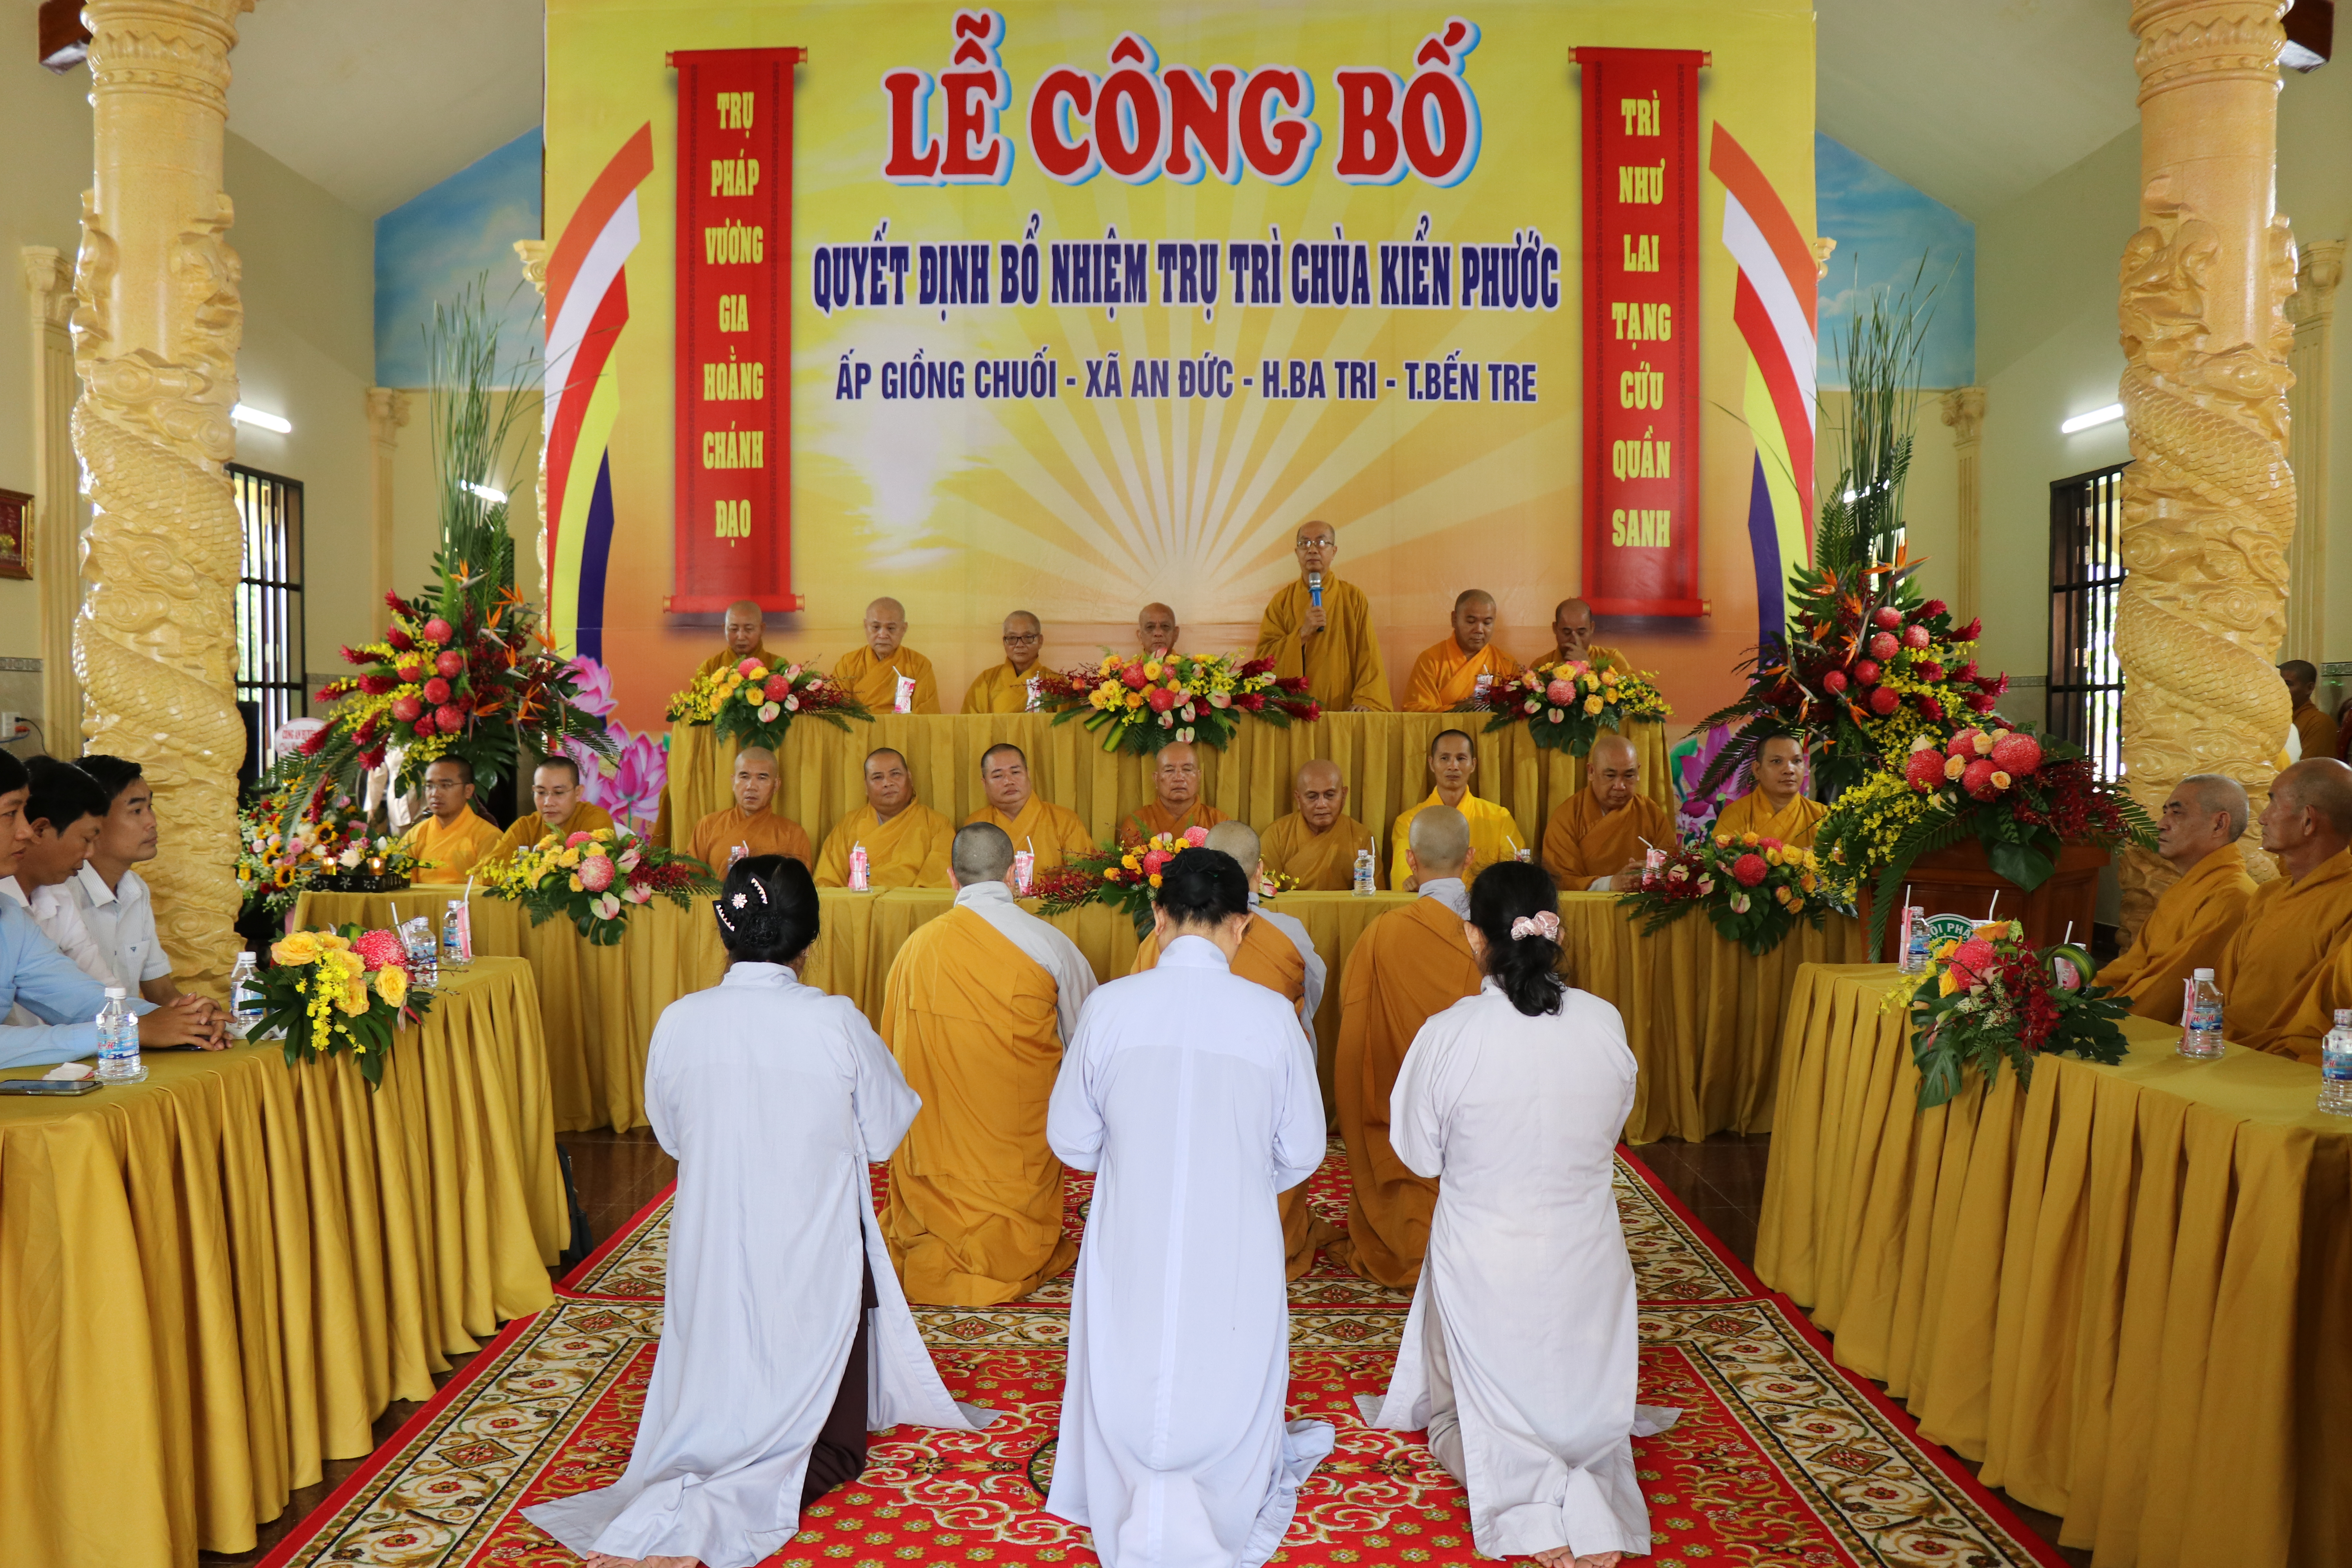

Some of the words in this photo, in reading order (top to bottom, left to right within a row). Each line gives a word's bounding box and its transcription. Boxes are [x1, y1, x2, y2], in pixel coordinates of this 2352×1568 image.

[717, 92, 754, 138] TRỤ
[884, 13, 1000, 178] LỄ
[1030, 36, 1307, 176] CÔNG
[1336, 21, 1468, 178] BỐ
[1621, 89, 1661, 136] TRÌ
[711, 149, 760, 197] PHÁP
[1619, 158, 1666, 205] NHƯ
[704, 218, 764, 265] VƯƠNG
[1623, 234, 1660, 272] LAI
[815, 221, 909, 314] QUYẾT
[920, 245, 989, 321] ĐỊNH
[1001, 213, 1040, 305] BỔ
[1052, 227, 1147, 319] NHIỆM
[1158, 243, 1218, 320] TRỤ
[1230, 227, 1281, 303] TRÌ
[1292, 227, 1370, 305] CHÙA
[1381, 215, 1451, 306] KIỂN
[1462, 230, 1558, 309] PHƯỚC
[719, 294, 749, 333] GIA
[1612, 302, 1671, 350] TẠNG
[703, 345, 764, 401] HOẰNG
[836, 348, 872, 400] ẤP
[882, 348, 965, 400] GIỒNG
[975, 346, 1056, 399] CHUỐI
[1086, 352, 1122, 397] XÃ
[1131, 360, 1169, 397] AN
[1178, 352, 1233, 398] ĐỨC
[1263, 361, 1326, 399] H.BA
[1334, 361, 1376, 399] TRI
[1405, 350, 1479, 401] T.BẾN
[1488, 363, 1537, 402] TRE
[1620, 361, 1664, 410] CỨU
[702, 420, 764, 470] CHÁNH
[1613, 425, 1671, 482] QUẦN
[715, 499, 751, 548] ĐẠO
[1612, 508, 1671, 548] SANH
[1929, 923, 1944, 937] ỘI
[1947, 922, 1972, 939] PHẬ
